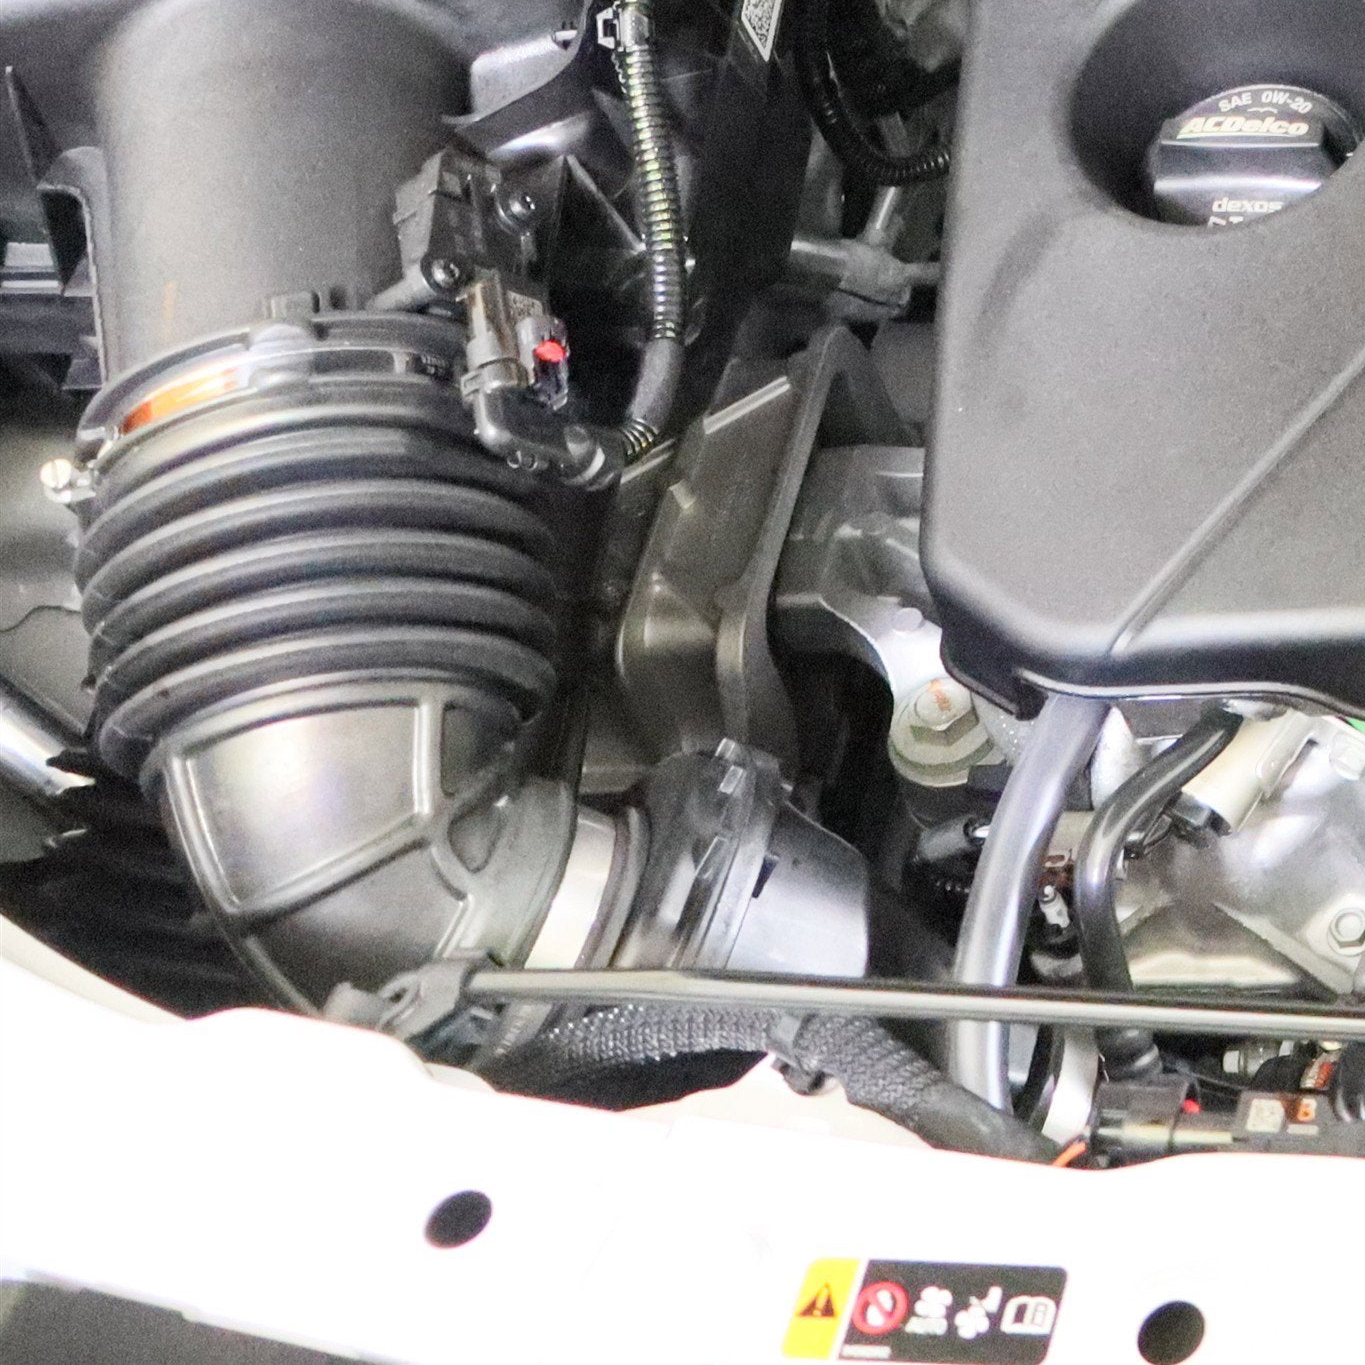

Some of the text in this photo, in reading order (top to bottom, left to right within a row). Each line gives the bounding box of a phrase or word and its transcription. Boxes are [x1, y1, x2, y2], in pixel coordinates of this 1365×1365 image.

[1218, 89, 1313, 114] SAE 0W-20
[1178, 115, 1310, 137] ACDelco
[1212, 196, 1284, 214] dexos
